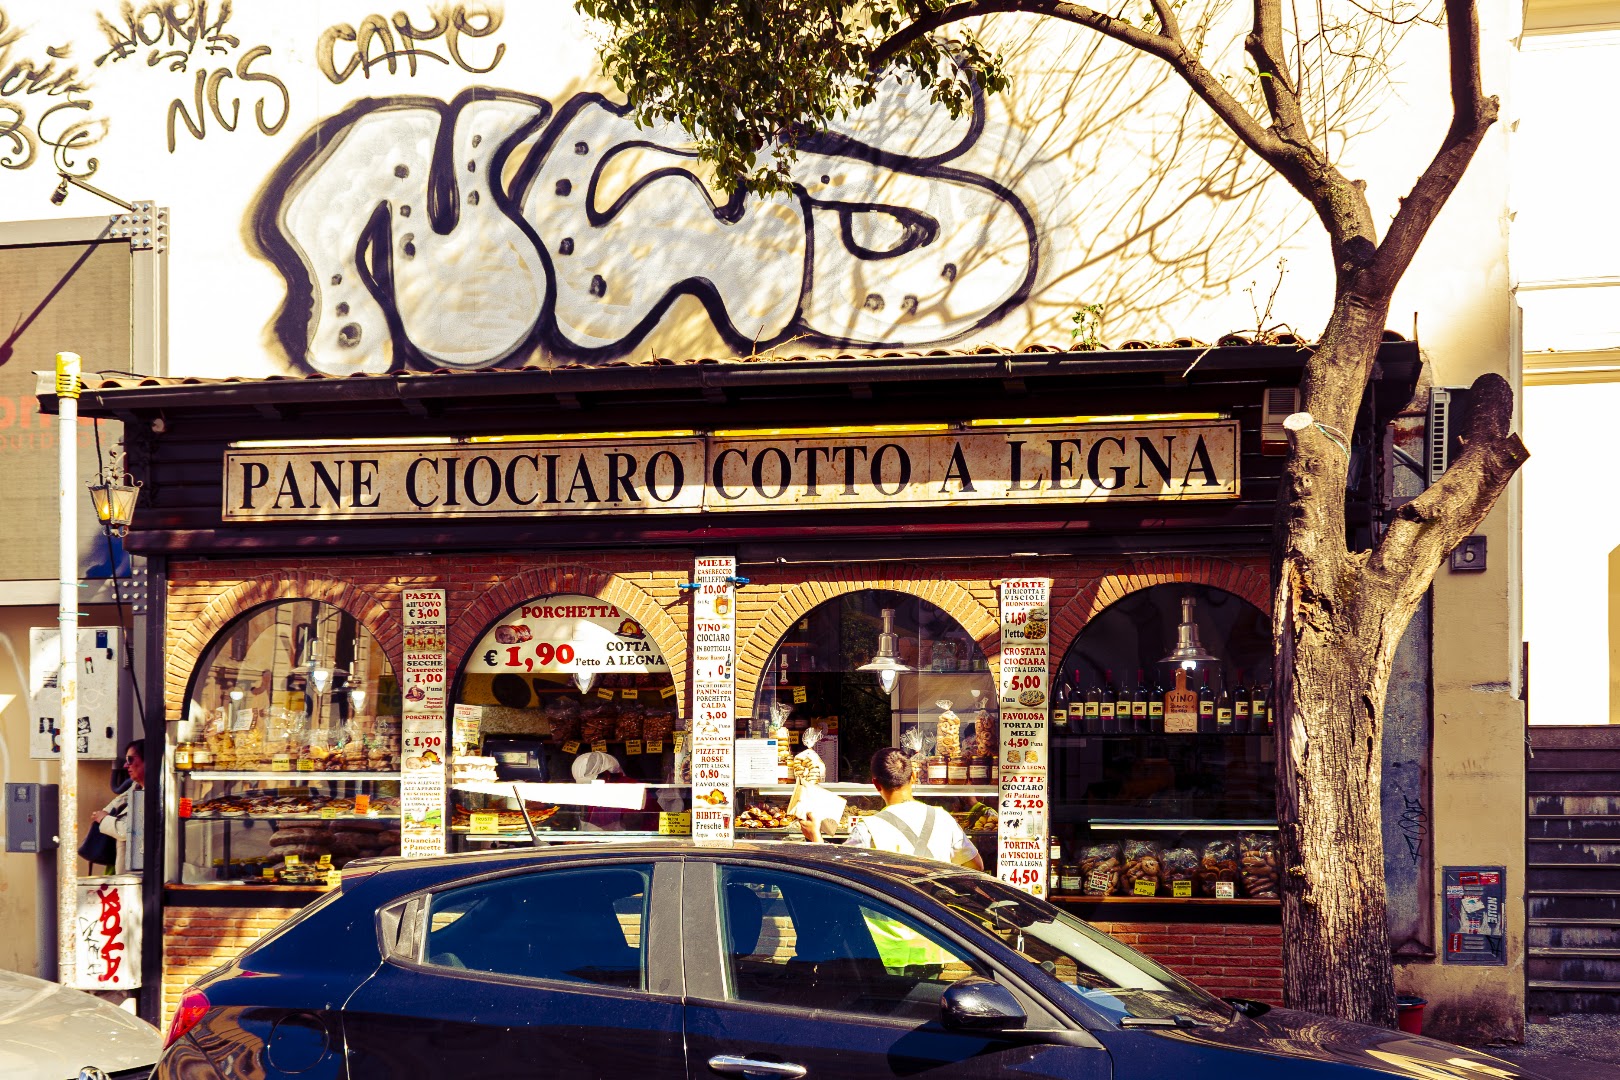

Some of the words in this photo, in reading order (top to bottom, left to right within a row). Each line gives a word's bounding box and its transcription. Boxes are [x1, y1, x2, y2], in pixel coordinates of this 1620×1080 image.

[0, 431, 107, 452] OUTDOR
[240, 460, 381, 510] PANE
[406, 450, 684, 508] CIOCIARO
[712, 443, 912, 500] COTTO
[940, 442, 978, 494] A
[1006, 434, 1222, 493] LEGNA
[703, 584, 727, 596] 10,00
[408, 609, 415, 617] €
[417, 609, 439, 619] 3,00
[521, 606, 620, 618] PORCHETTA
[1005, 613, 1009, 624] €
[1011, 612, 1026, 626] 1,50
[1004, 629, 1024, 638] l'etto
[606, 642, 650, 652] COTTA
[483, 650, 498, 666] €
[505, 643, 574, 672] 1,90
[576, 658, 600, 666] l'etto
[606, 656, 615, 666] A
[619, 655, 665, 666] LEGNA
[414, 674, 442, 685] 1,00
[1012, 676, 1040, 692] 5,00
[706, 712, 727, 721] 3,00
[405, 738, 411, 746] €
[413, 737, 441, 748] 1,90
[1008, 738, 1029, 749] 4,50
[700, 770, 719, 780] 0,80
[1014, 800, 1044, 810] 2,20
[1004, 841, 1040, 849] TORTINA
[1009, 869, 1039, 886] 4,50
